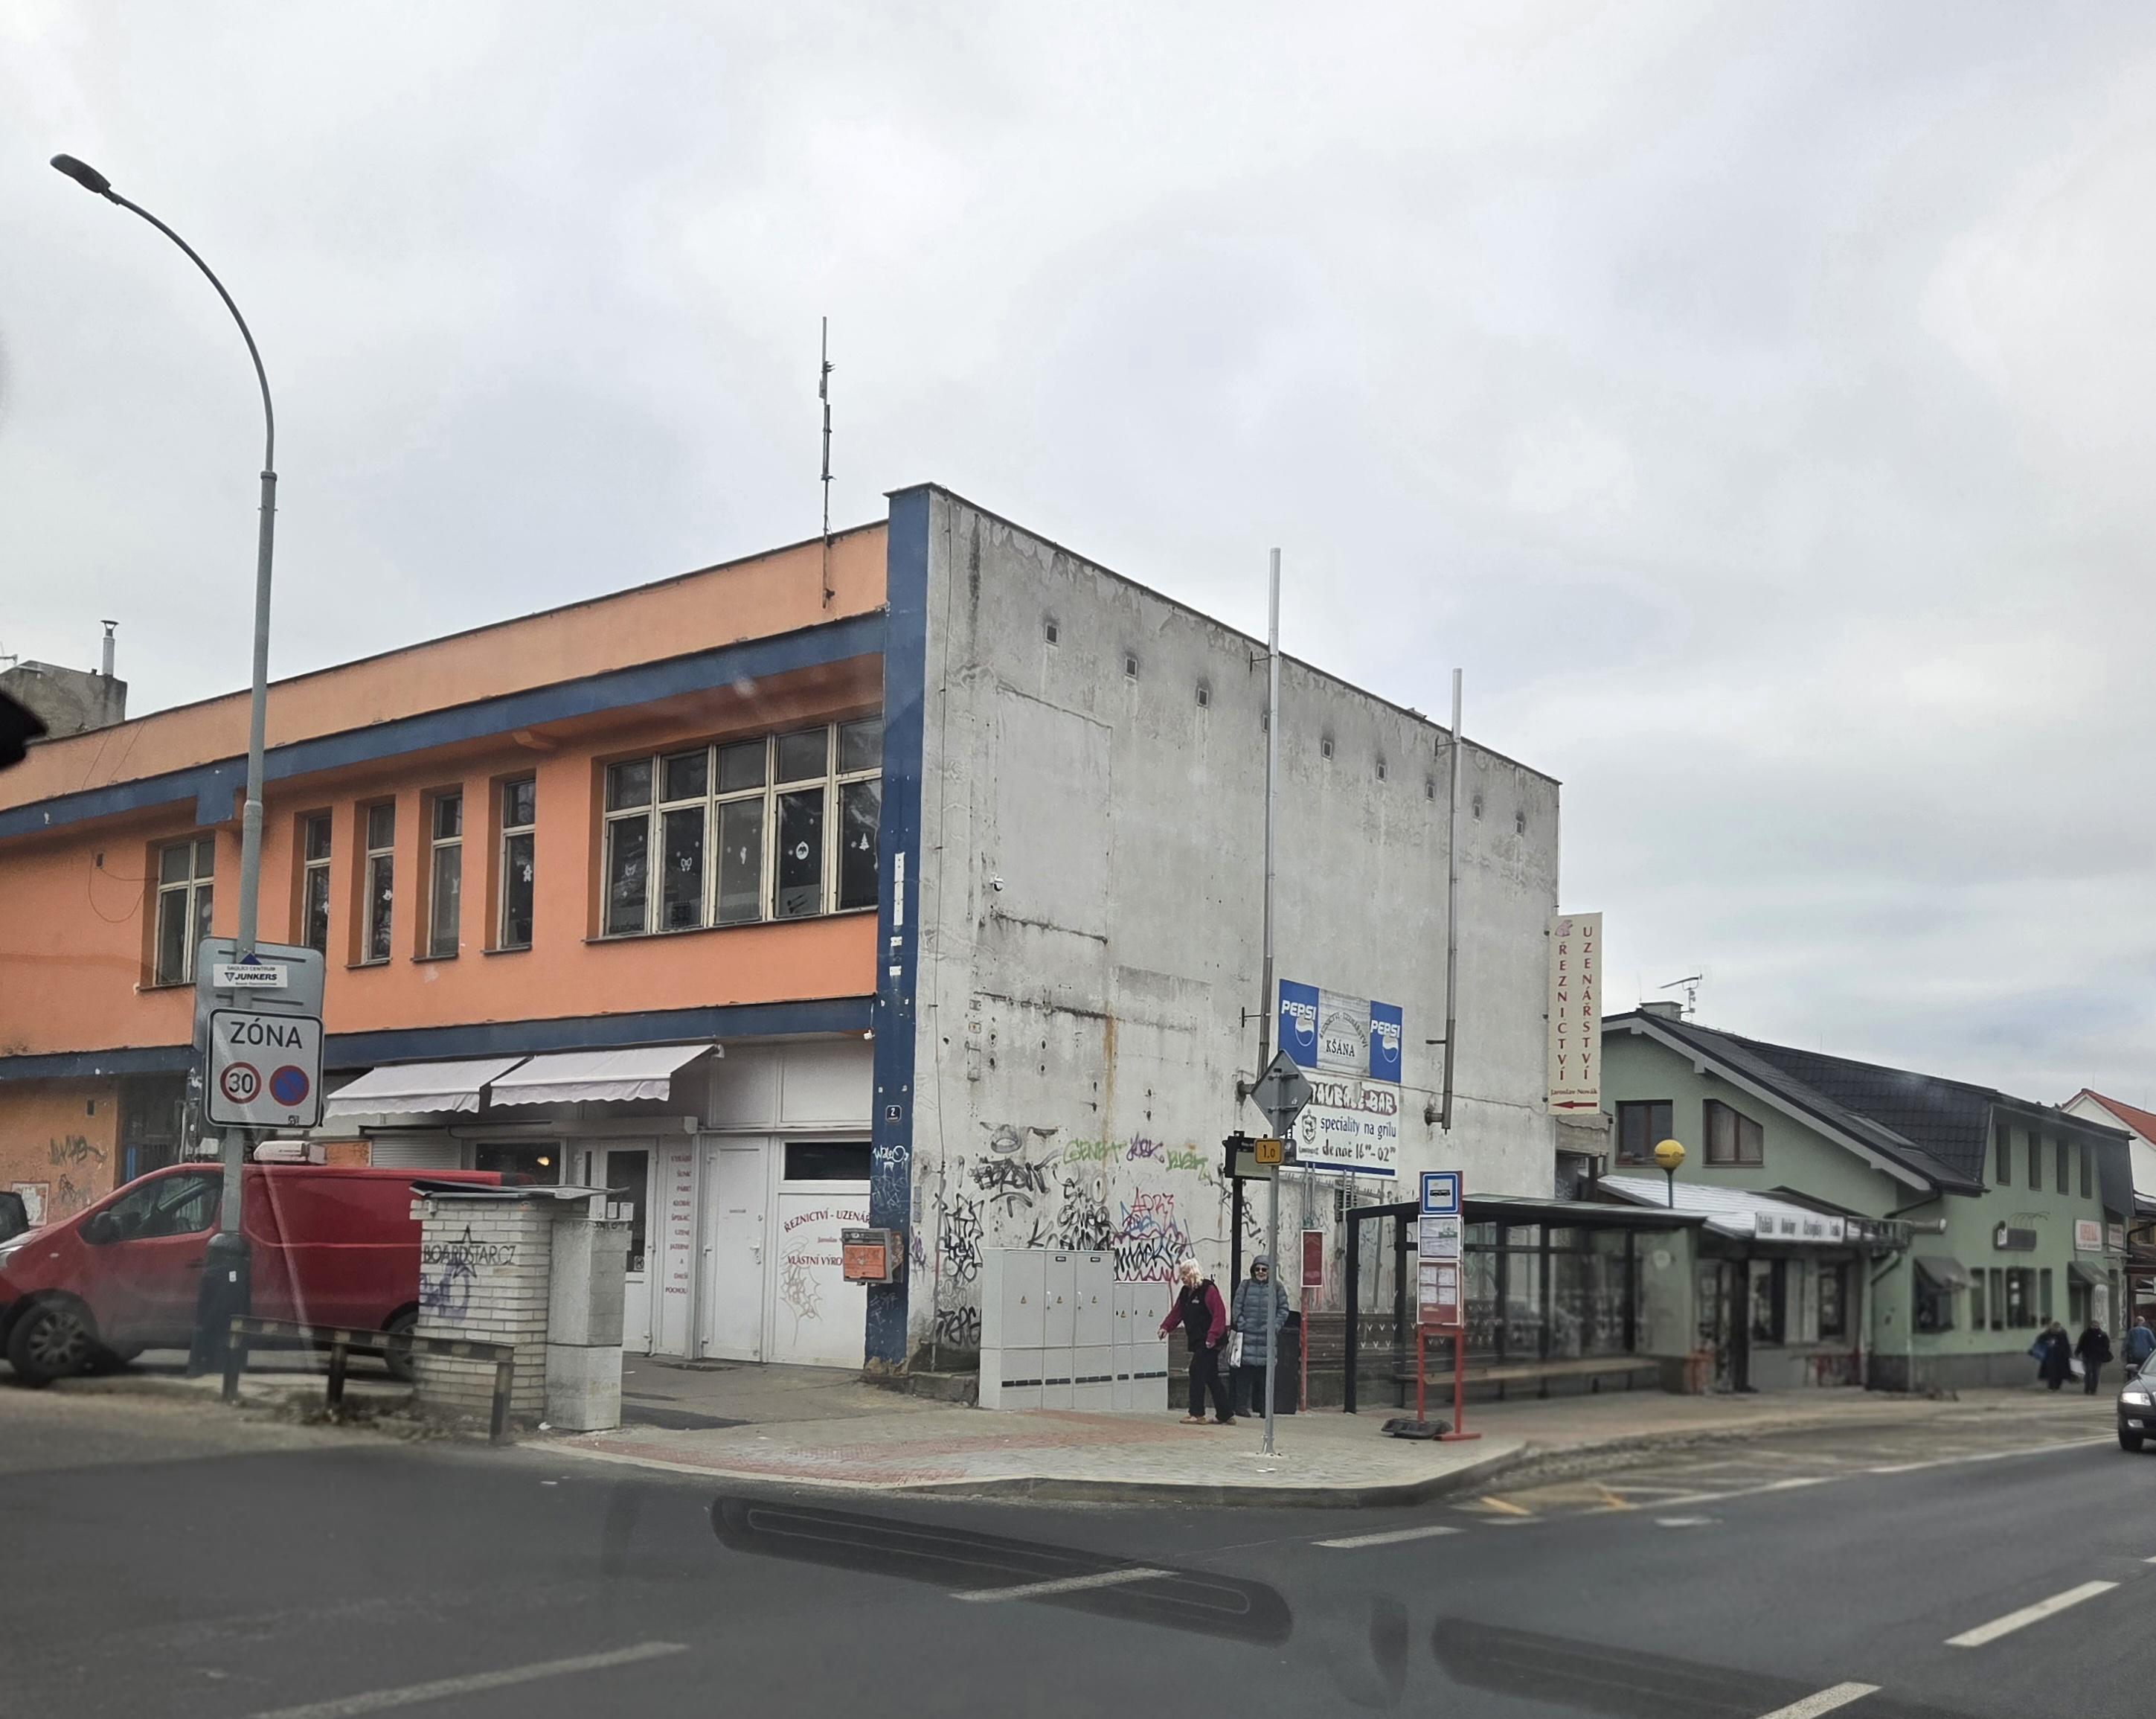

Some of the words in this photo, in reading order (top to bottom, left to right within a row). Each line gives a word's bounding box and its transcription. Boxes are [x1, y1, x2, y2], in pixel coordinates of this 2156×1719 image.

[1281, 1000, 1317, 1020] PEPSI
[1557, 941, 1568, 1081] ŘEZNICTVÍ
[1582, 926, 1593, 1080] UZENÁŘSTVÍ
[230, 1018, 303, 1049] ZÓNA
[1370, 1019, 1401, 1039] PEPSI
[1326, 1039, 1355, 1057] KŠÁNA
[228, 1072, 254, 1094] 30
[891, 1107, 896, 1116] 2
[1321, 1116, 1360, 1136] speciality
[1364, 1123, 1374, 1135] na
[1377, 1121, 1396, 1140] grilu
[783, 1207, 829, 1232] ŘEZNICTVÍ
[788, 1254, 819, 1266] VLASTNÍ
